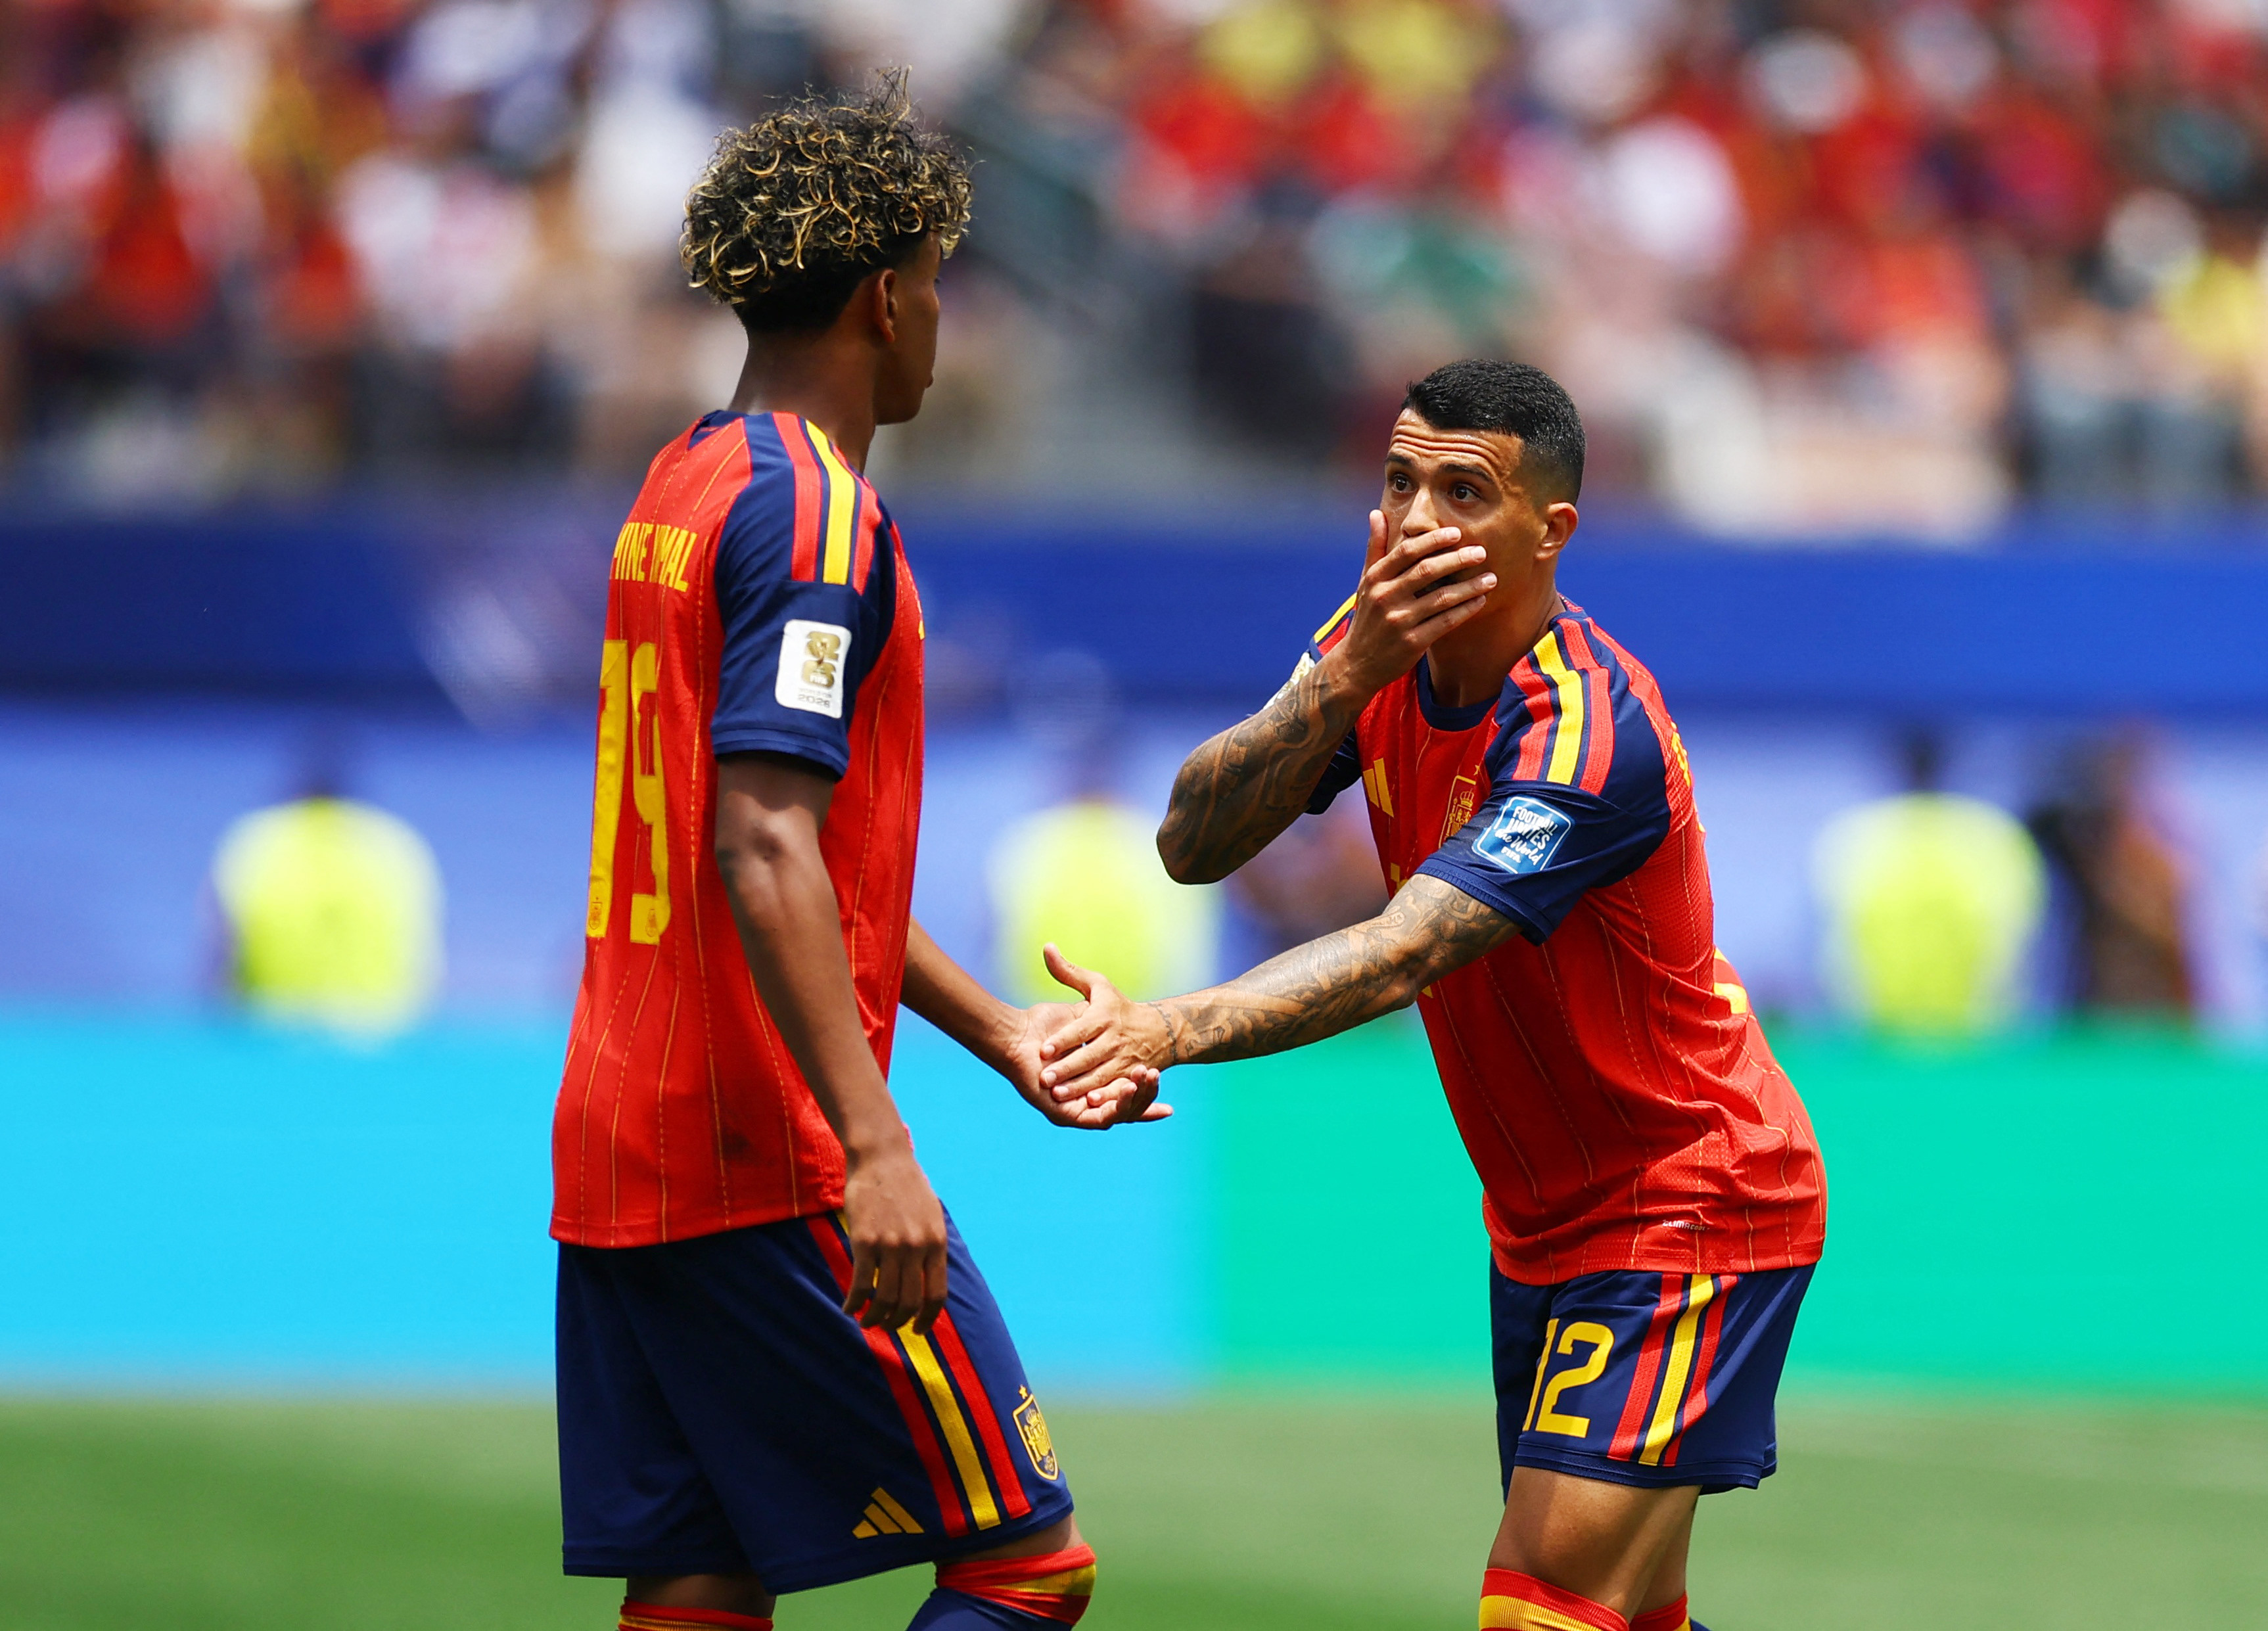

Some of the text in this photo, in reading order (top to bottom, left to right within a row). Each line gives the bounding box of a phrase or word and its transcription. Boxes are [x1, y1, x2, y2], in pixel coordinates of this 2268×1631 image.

[586, 640, 672, 945] 19
[1513, 806, 1558, 837] FOOTBALL
[1500, 846, 1521, 863] FIFA
[1522, 1318, 1615, 1438] 12
